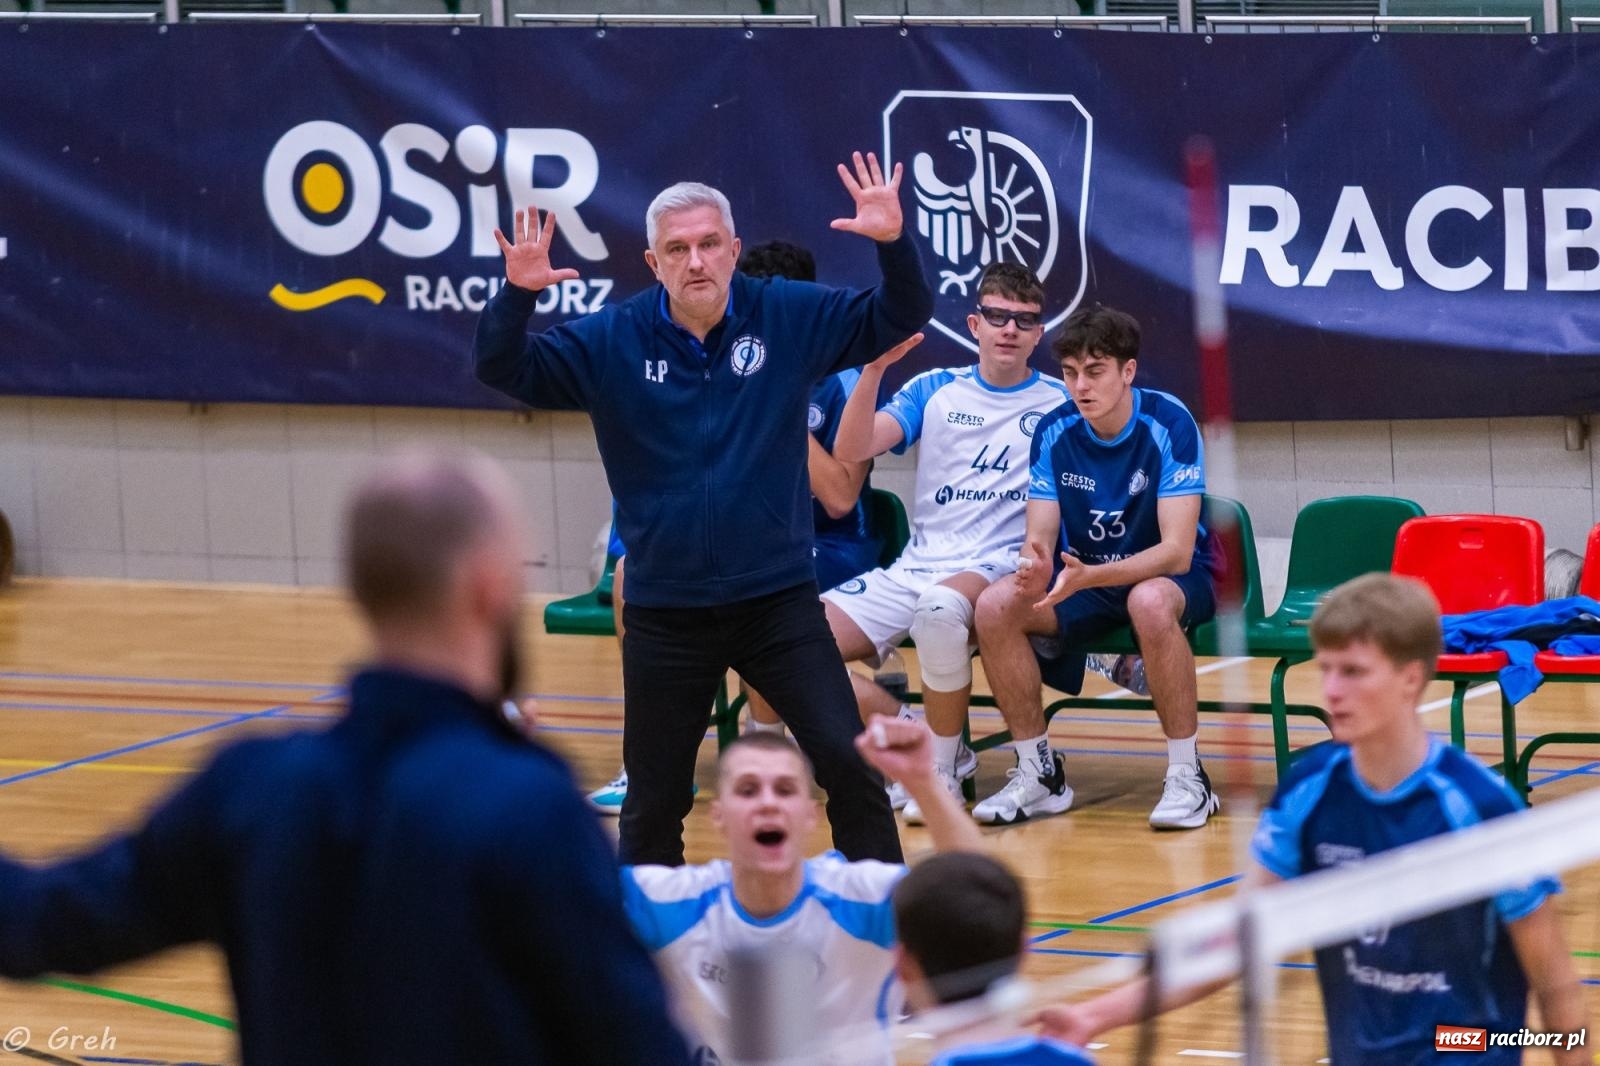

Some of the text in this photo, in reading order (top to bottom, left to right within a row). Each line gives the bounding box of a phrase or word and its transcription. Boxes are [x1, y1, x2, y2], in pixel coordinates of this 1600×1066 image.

[405, 274, 614, 314] RACIORZ
[971, 444, 1011, 474] 44
[1088, 509, 1126, 541] 33
